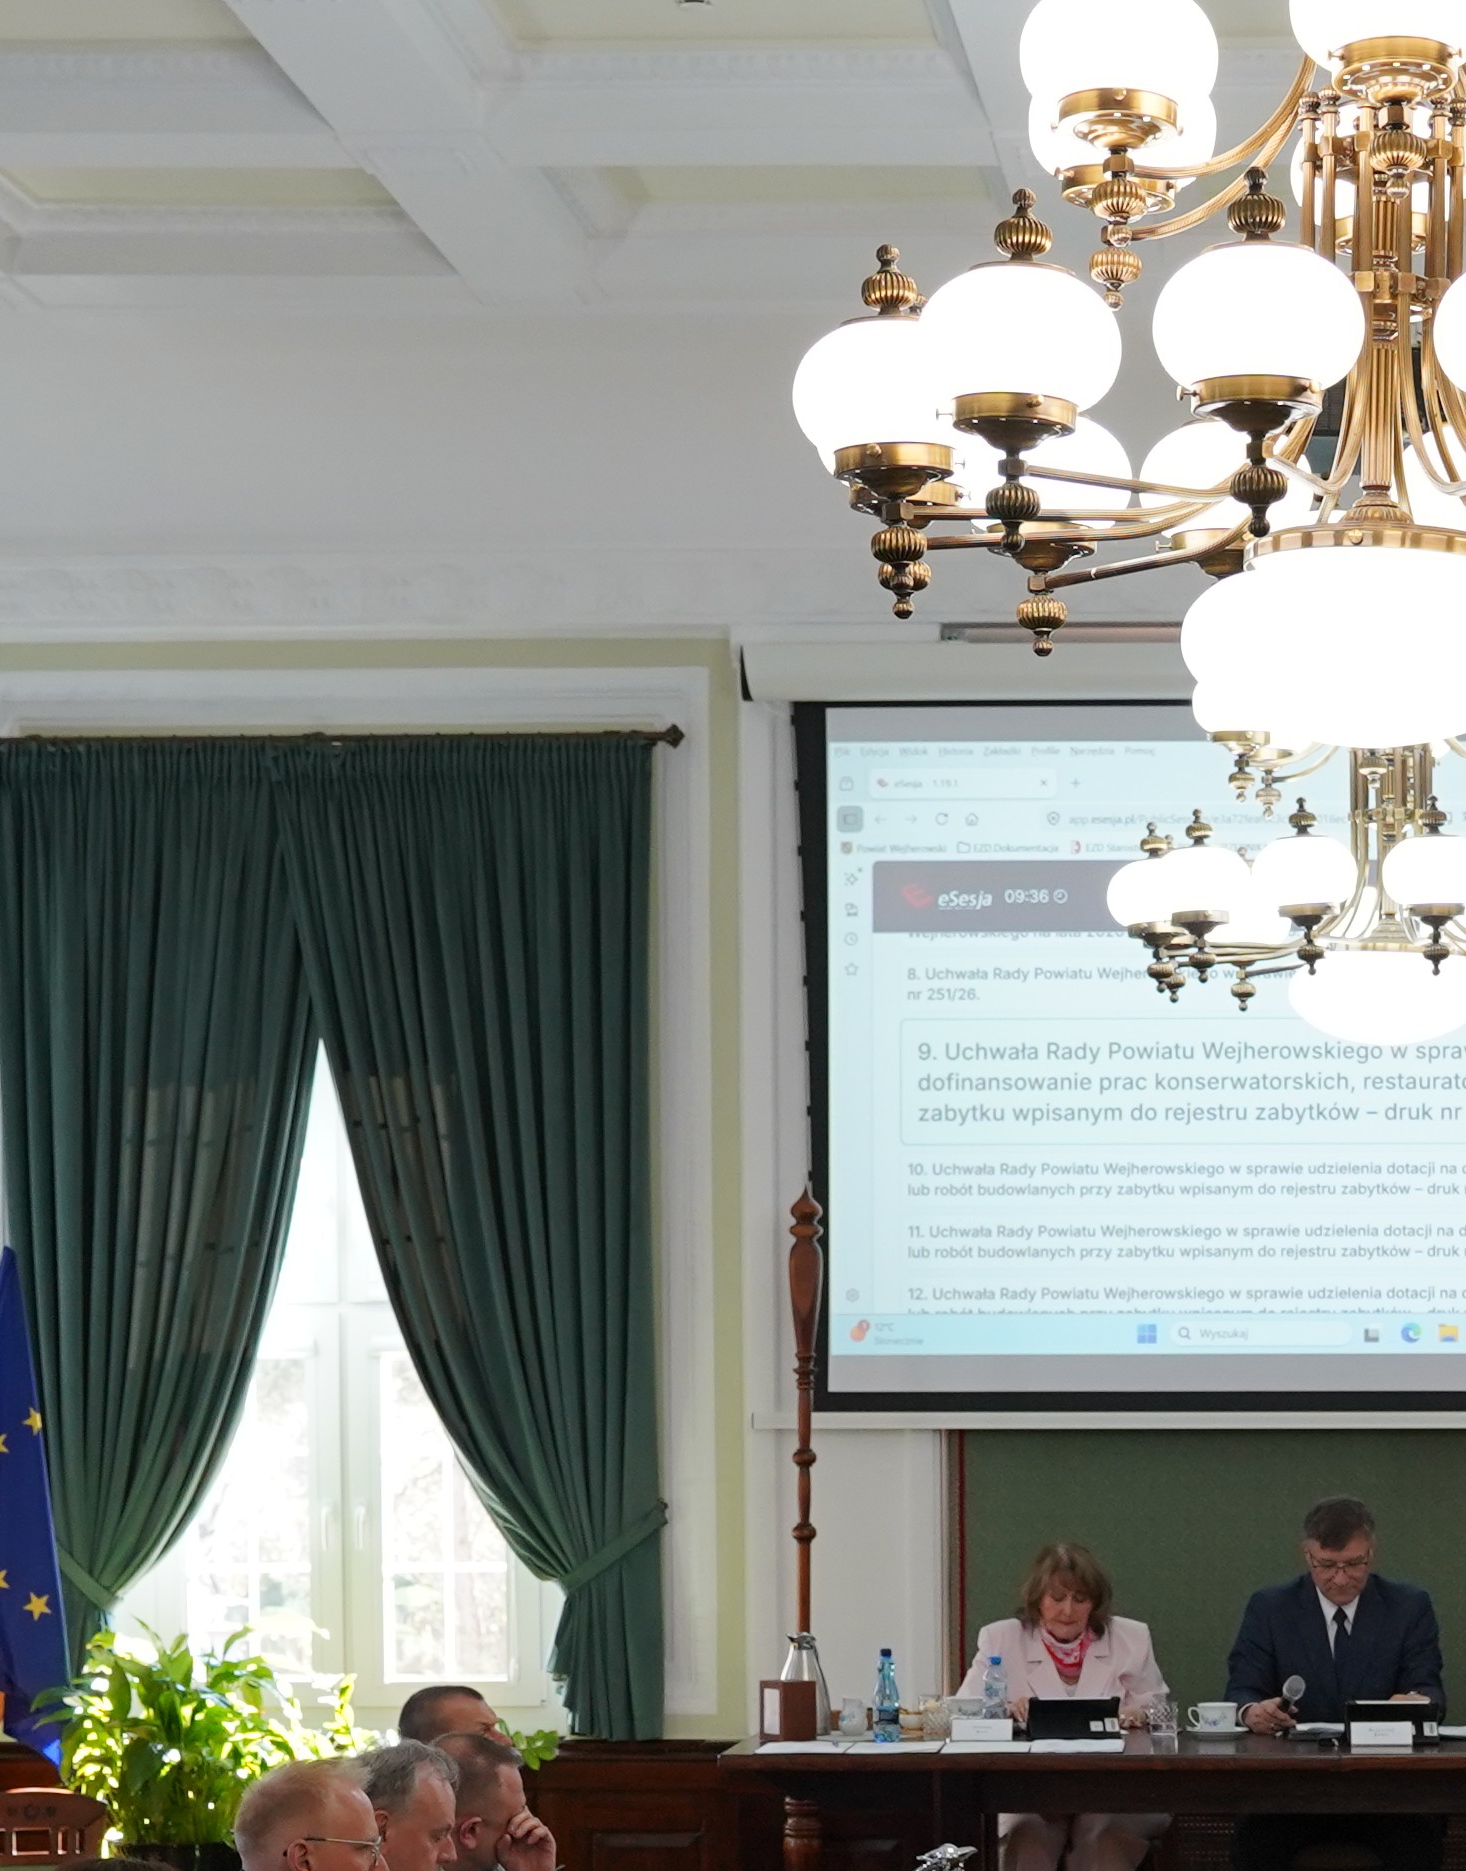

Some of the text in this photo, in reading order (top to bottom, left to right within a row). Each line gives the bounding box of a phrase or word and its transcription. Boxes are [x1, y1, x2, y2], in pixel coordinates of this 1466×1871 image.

[937, 890, 993, 910] eSesja
[1004, 889, 1050, 904] 09:36
[907, 967, 921, 981] 8.
[925, 967, 989, 981] Uchwała
[993, 966, 1031, 984] Rady
[1034, 966, 1093, 981] Powiatu
[907, 987, 981, 1003] nr 251/26.
[917, 1041, 938, 1062] 9.
[944, 1041, 1039, 1062] Uchwała
[1046, 1041, 1102, 1066] Rady
[1108, 1040, 1195, 1061] Powiatu
[1201, 1040, 1384, 1065] Wejherowskiego
[1389, 1045, 1409, 1060] w
[917, 1071, 1093, 1092] dofinansowanie
[1099, 1075, 1148, 1096] prac
[1154, 1071, 1356, 1094] konserwatorskich,
[917, 1103, 1006, 1127] zabytku
[1011, 1102, 1123, 1127] wpisanym
[1129, 1102, 1158, 1122] do
[1164, 1102, 1248, 1126] rejestru
[1254, 1101, 1361, 1126] zabytków
[1383, 1102, 1434, 1121] druk
[1440, 1106, 1463, 1121] nr
[907, 1162, 928, 1177] 10.
[931, 1162, 996, 1177] Uchwała
[999, 1162, 1037, 1179] Rady
[1040, 1162, 1100, 1176] Powiatu
[1102, 1161, 1226, 1179] Wejherowskiego
[1228, 1164, 1243, 1175] w
[1245, 1161, 1304, 1178] sprawie
[1307, 1161, 1383, 1175] udzielenia
[1386, 1161, 1436, 1178] dotacji
[1439, 1164, 1458, 1176] na
[907, 1183, 931, 1197] lub
[934, 1182, 974, 1197] robót
[977, 1182, 1076, 1200] budowlanych
[1079, 1185, 1113, 1199] przy
[1116, 1182, 1175, 1199] zabytku
[1178, 1182, 1254, 1199] wpisanym
[1257, 1182, 1277, 1196] do
[1280, 1181, 1337, 1199] rejestru
[1340, 1182, 1412, 1199] zabytków
[1426, 1181, 1461, 1196] druk
[907, 1224, 925, 1239] 11.
[928, 1225, 993, 1239] Uchwała
[996, 1224, 1034, 1241] Rady
[1037, 1224, 1097, 1239] Powiatu
[1099, 1224, 1223, 1241] Wejherowskiego
[1225, 1226, 1239, 1238] w
[1242, 1223, 1301, 1241] sprawie
[1304, 1223, 1380, 1238] udzielenia
[1382, 1223, 1433, 1241] dotacji
[1436, 1226, 1455, 1238] na
[907, 1245, 931, 1259] lub
[934, 1245, 974, 1259] robót
[977, 1245, 1076, 1262] budowlanych
[1079, 1247, 1113, 1262] przy
[1116, 1244, 1175, 1262] zabytku
[1178, 1244, 1254, 1261] wpisanym
[1257, 1244, 1277, 1258] do
[1280, 1244, 1337, 1261] rejestru
[1340, 1244, 1412, 1261] zabytków
[1426, 1244, 1461, 1258] druk
[907, 1287, 928, 1301] 12.
[932, 1287, 996, 1301] Uchwała
[999, 1286, 1037, 1303] Rady
[1040, 1286, 1100, 1301] Powiatu
[1103, 1286, 1226, 1303] Wejherowskiego
[1228, 1289, 1242, 1300] w
[1245, 1286, 1304, 1303] sprawie
[1307, 1286, 1383, 1300] udzielenia
[1385, 1285, 1436, 1302] dotacji
[1439, 1288, 1458, 1300] na
[1199, 1327, 1249, 1341] Wyszukaj
